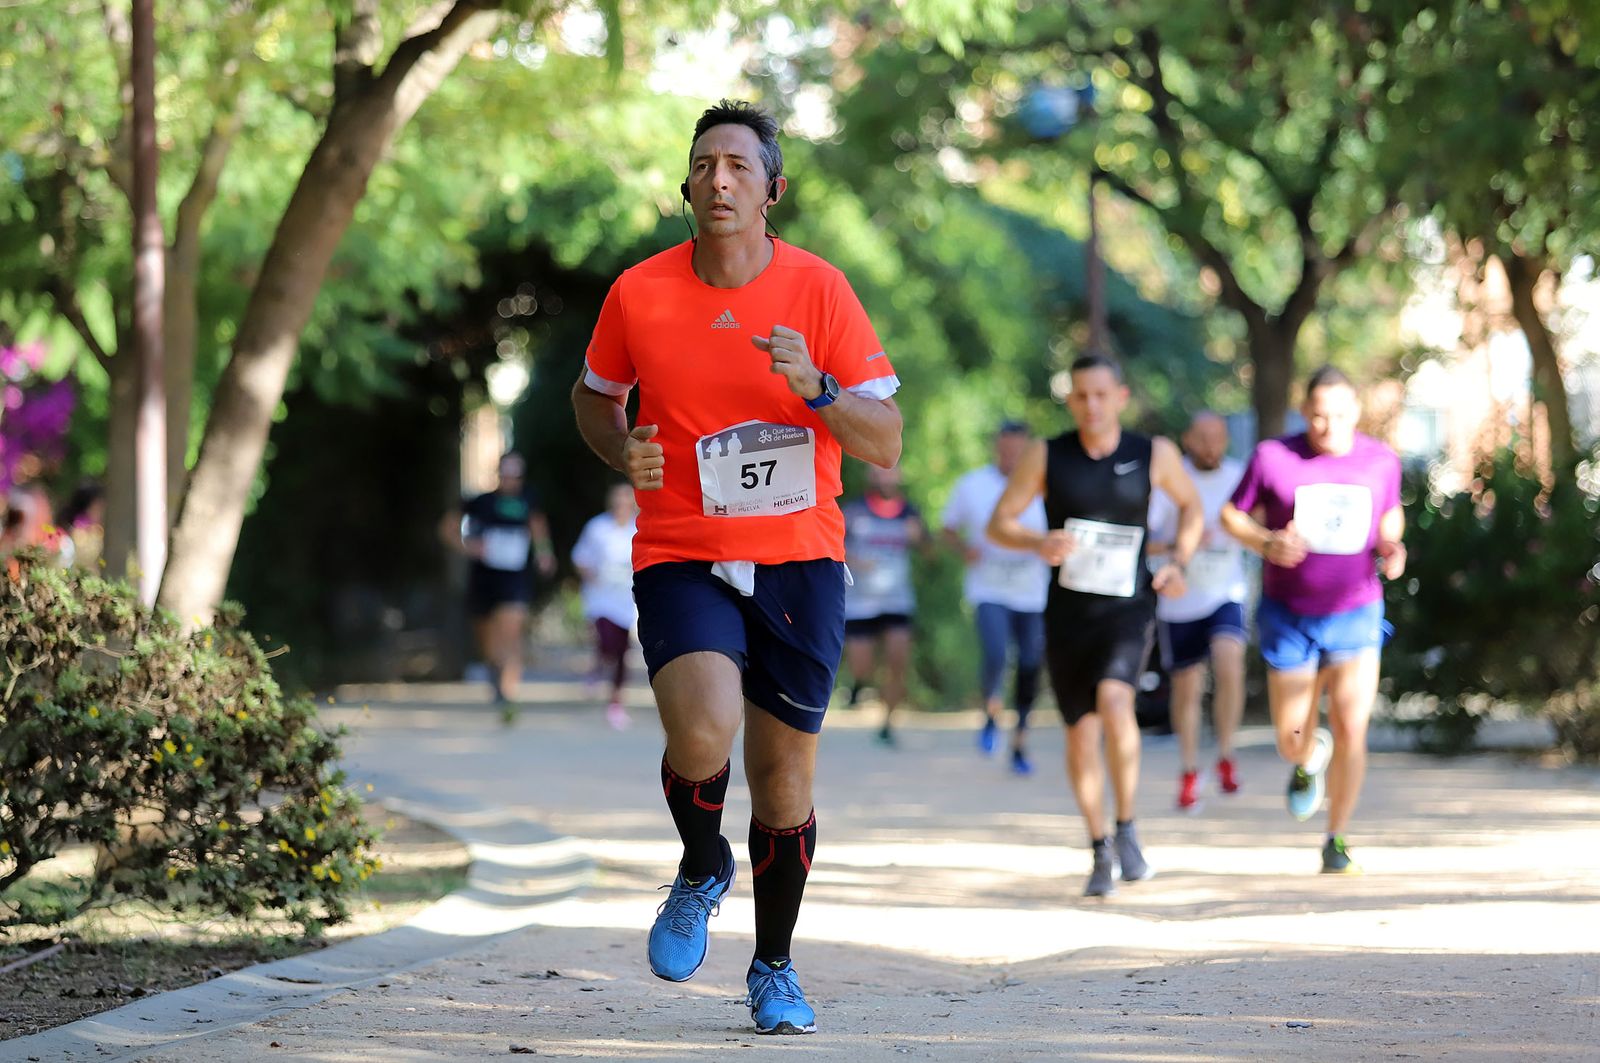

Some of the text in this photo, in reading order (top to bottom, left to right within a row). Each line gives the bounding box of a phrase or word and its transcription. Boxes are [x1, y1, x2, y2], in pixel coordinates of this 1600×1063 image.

[782, 432, 804, 440] Huelva
[741, 459, 777, 490] 57
[738, 504, 760, 513] HUELVA
